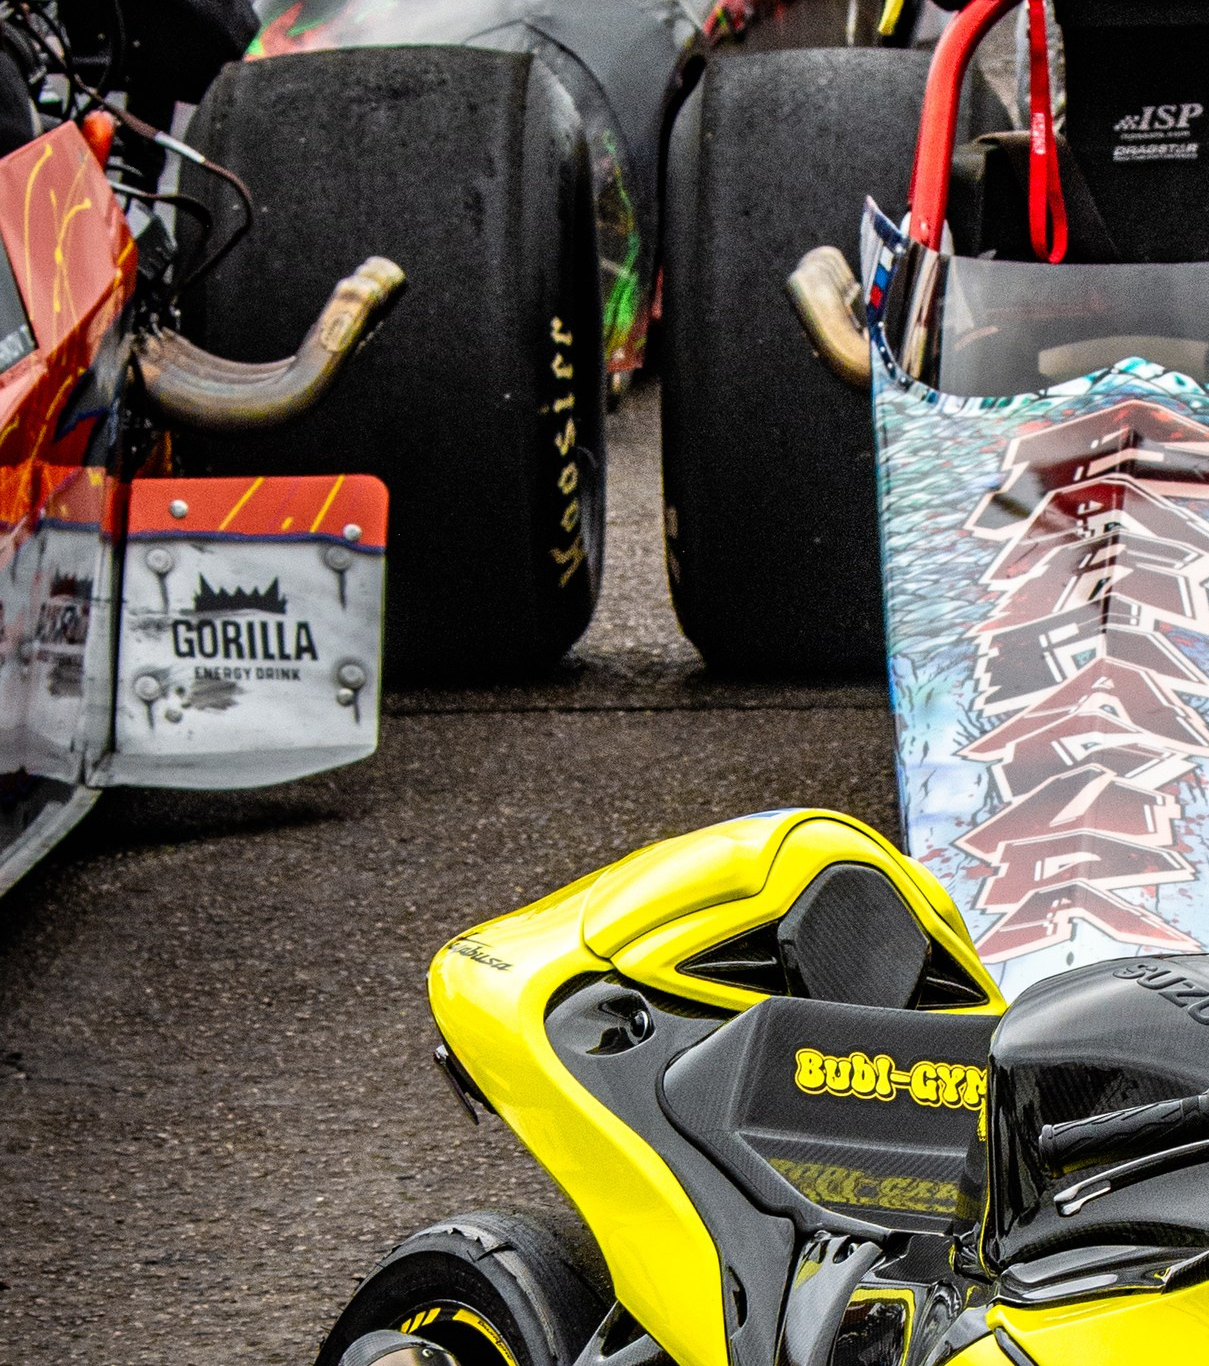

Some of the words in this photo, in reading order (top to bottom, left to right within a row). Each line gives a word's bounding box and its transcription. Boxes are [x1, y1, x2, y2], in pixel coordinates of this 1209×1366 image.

[1138, 102, 1205, 131] ISP
[171, 618, 319, 661] GORILLA
[194, 665, 251, 682] ENERGY
[256, 666, 301, 682] DRINK
